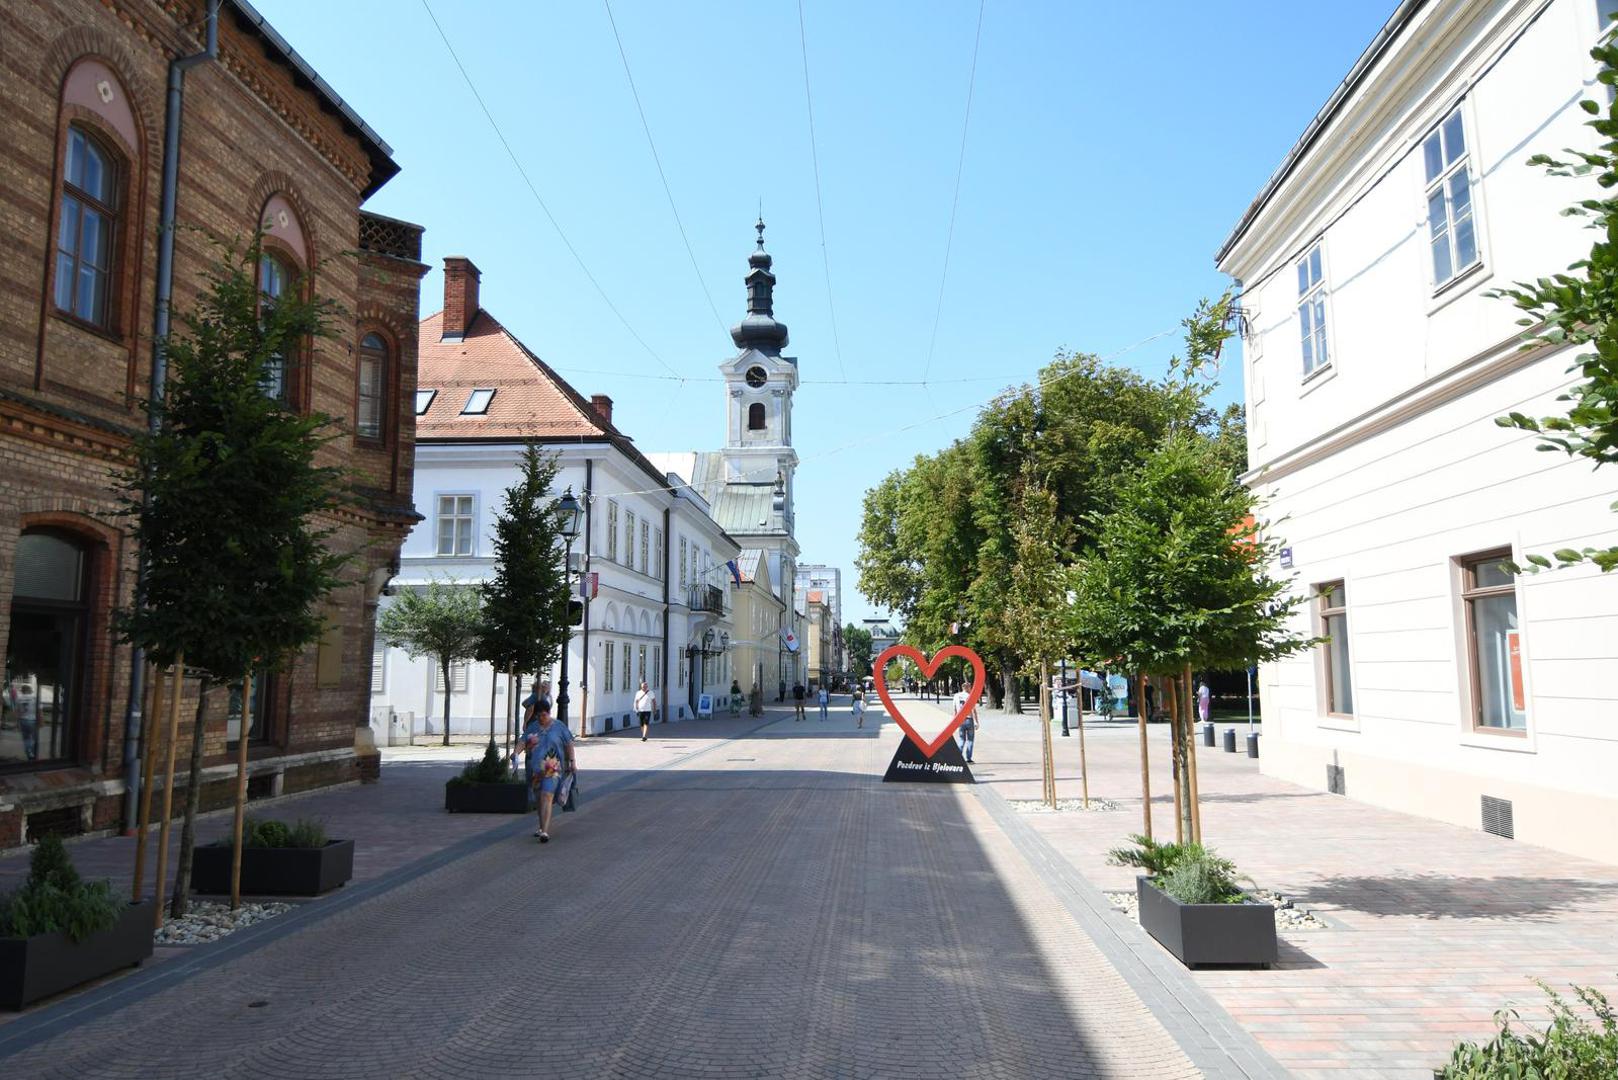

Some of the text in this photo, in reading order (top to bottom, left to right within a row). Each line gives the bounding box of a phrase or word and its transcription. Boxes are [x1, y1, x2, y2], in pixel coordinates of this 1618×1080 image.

[896, 760, 964, 773] Pozdrav iz Bjelovara
